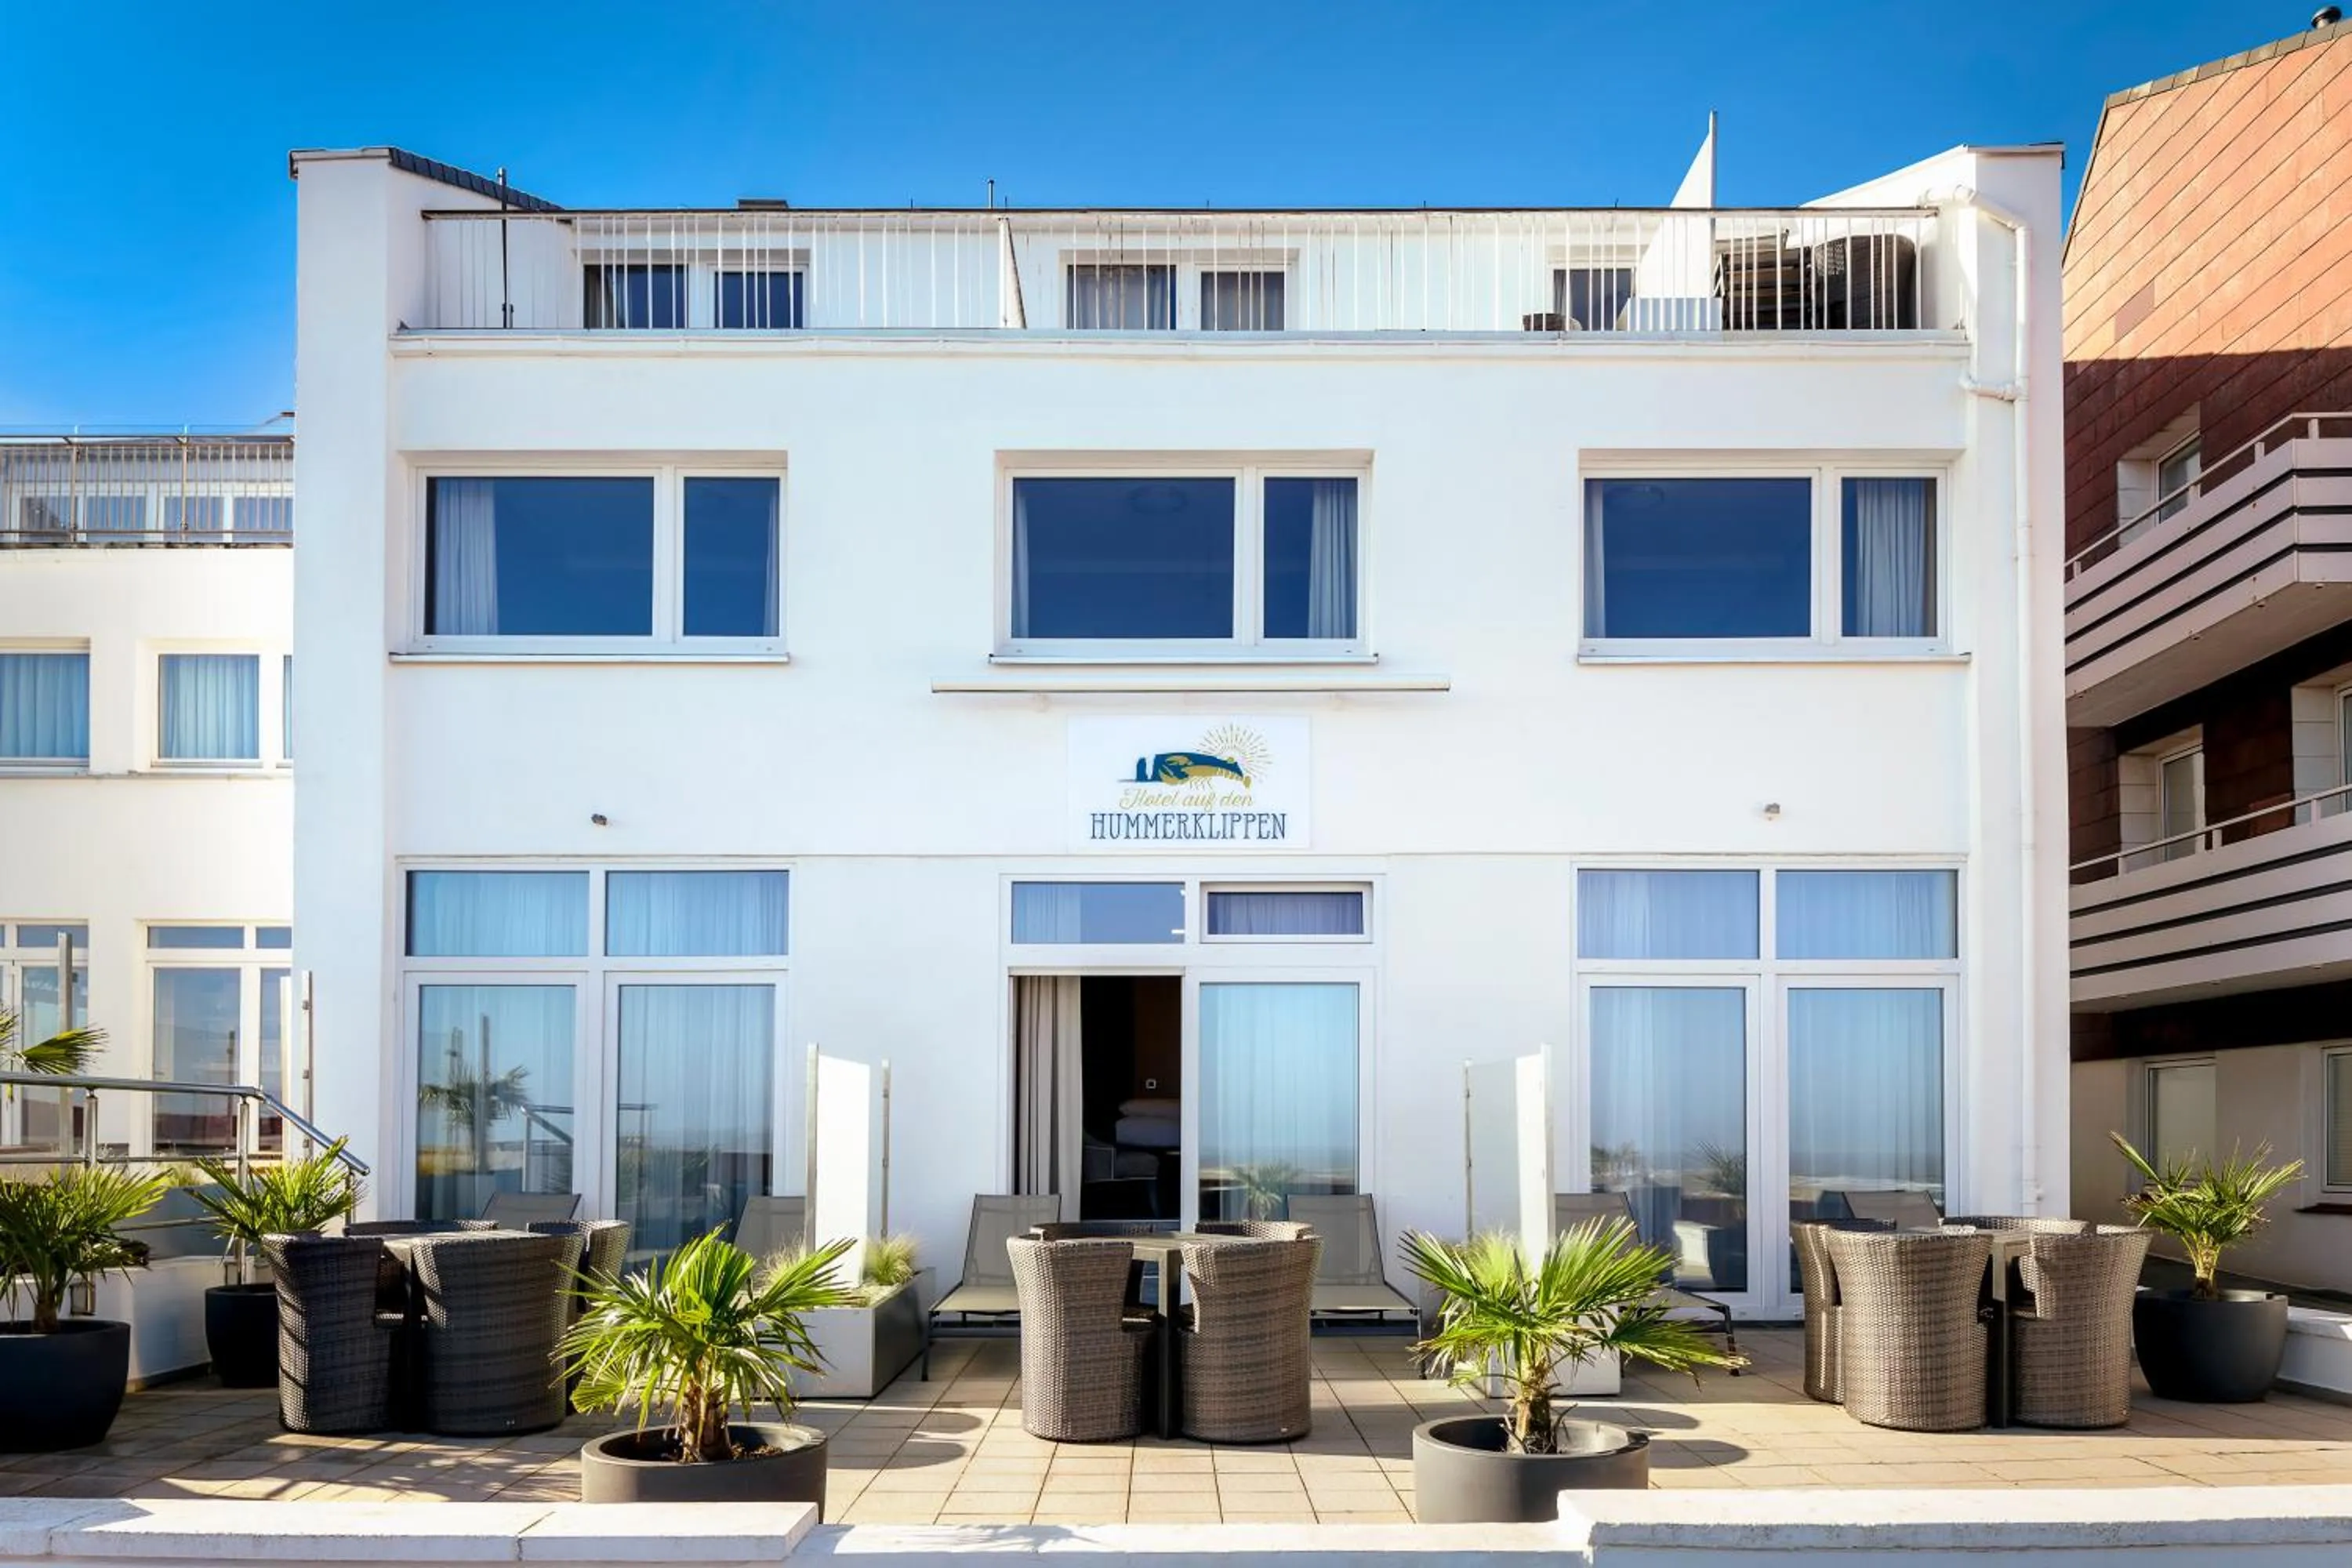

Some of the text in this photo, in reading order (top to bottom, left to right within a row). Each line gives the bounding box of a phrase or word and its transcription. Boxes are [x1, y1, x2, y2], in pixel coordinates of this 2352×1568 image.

[1119, 788, 1254, 812] Hotel auf den
[1090, 812, 1287, 840] HUMMERKLIPPEN
